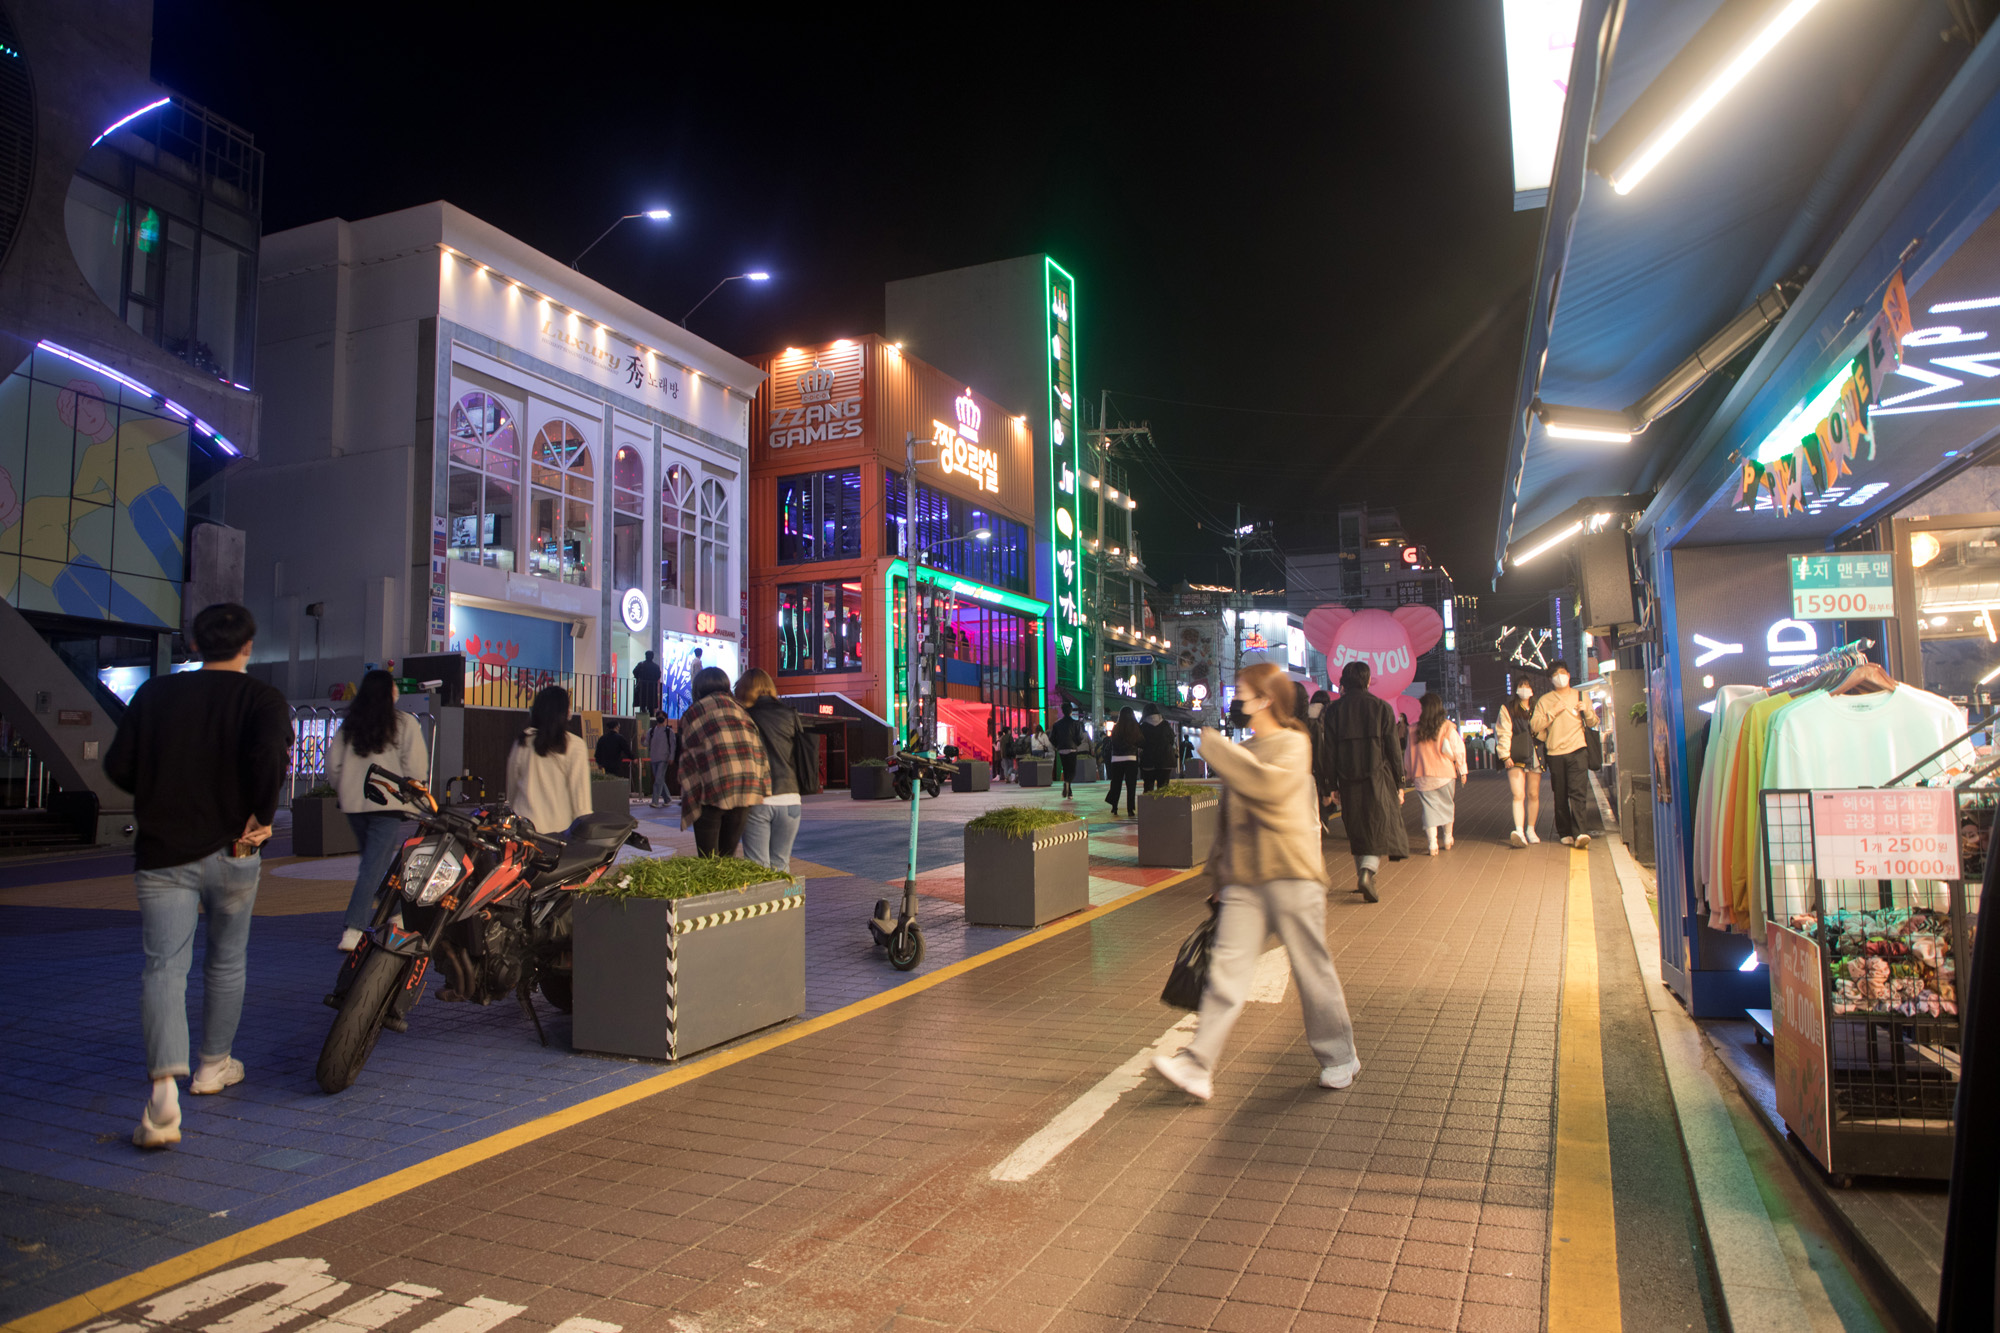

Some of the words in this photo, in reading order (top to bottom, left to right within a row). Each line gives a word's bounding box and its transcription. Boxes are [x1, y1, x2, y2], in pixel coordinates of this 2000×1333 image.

[541, 320, 621, 370] Luxury
[626, 355, 644, 389] 秀
[647, 371, 680, 400] 노래방
[769, 397, 863, 430] ZZANG
[769, 418, 863, 449] GAMES
[931, 418, 999, 494] 짱오락실
[1403, 547, 1417, 564] G
[1837, 561, 1889, 579] 맨투맨
[696, 612, 716, 634] SU
[1333, 644, 1370, 671] SEE
[1372, 644, 1410, 676] YOU
[1842, 795, 1875, 811] 헤어
[1882, 794, 1933, 811] 집게핀
[1843, 813, 1876, 830] 곱창
[1884, 812, 1934, 829] 머리끈
[406, 957, 429, 990] KTM
